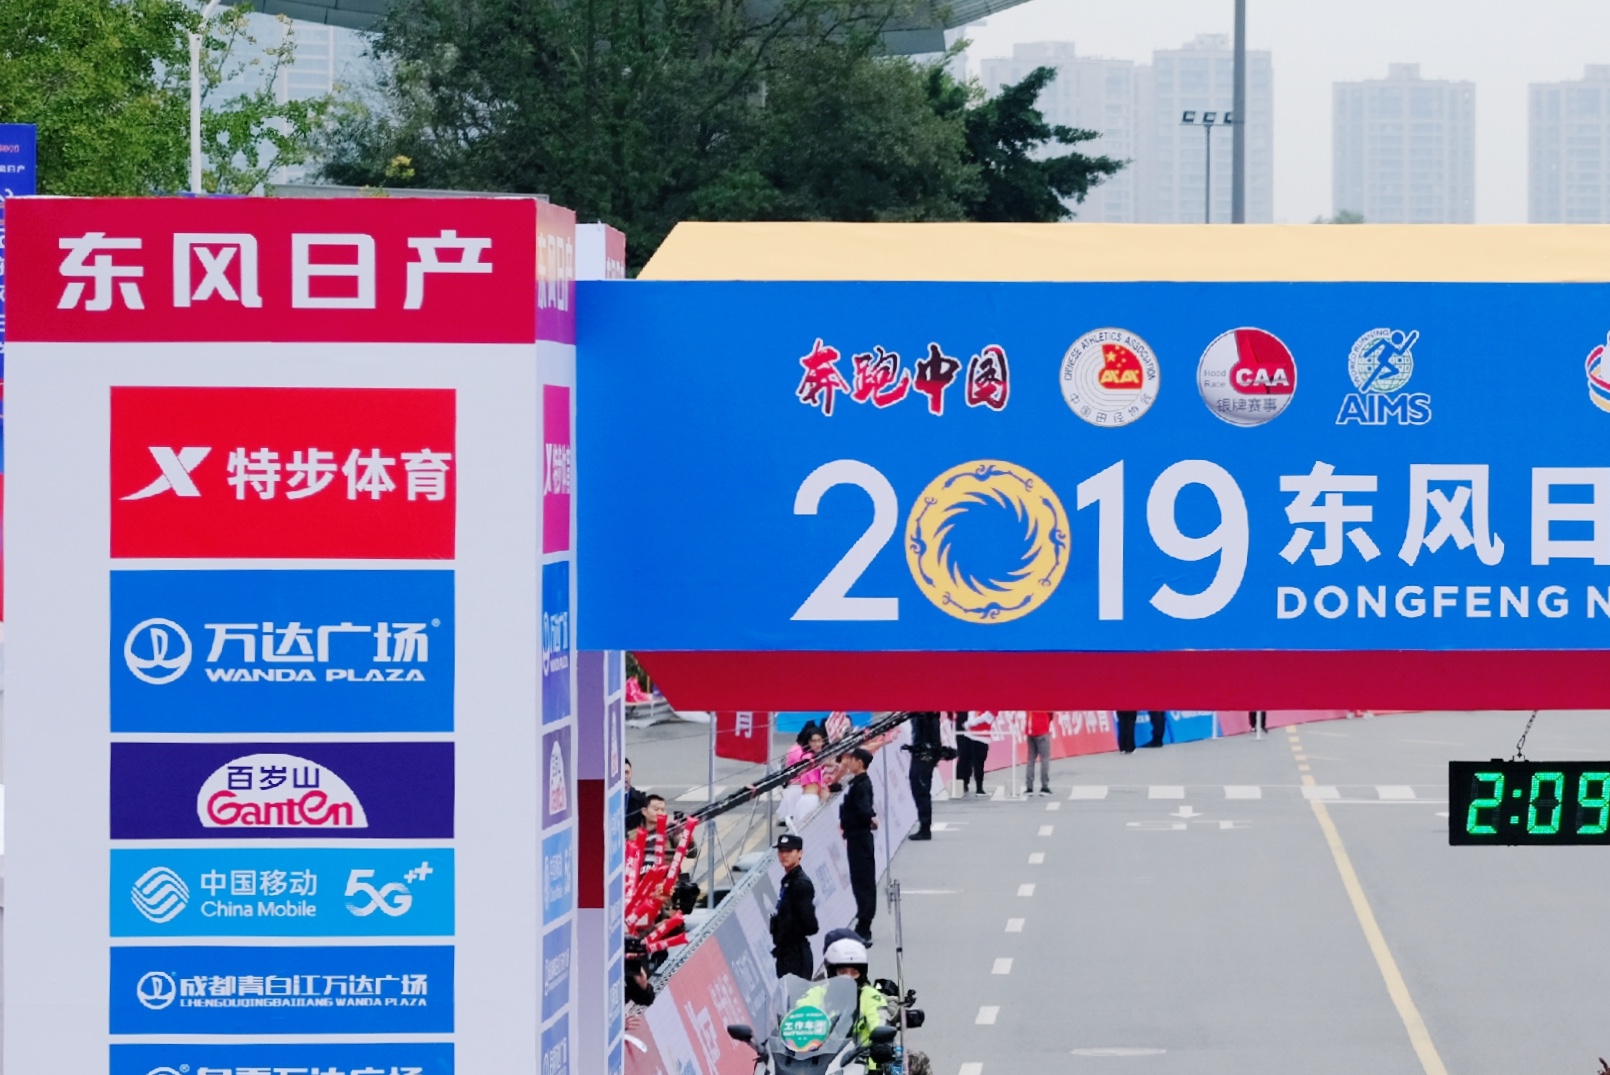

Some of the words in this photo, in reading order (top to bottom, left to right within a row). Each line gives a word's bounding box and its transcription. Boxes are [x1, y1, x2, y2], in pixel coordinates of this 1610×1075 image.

[57, 229, 494, 311] 东风日产
[796, 338, 1009, 417] 奔跑中国
[1235, 367, 1290, 387] CAA
[1336, 393, 1432, 425] AIMS
[227, 448, 452, 501] 特步体育
[1276, 585, 1570, 619] DONGFENG
[204, 621, 428, 663] 万达广场
[205, 668, 317, 682] WANDA
[325, 668, 426, 682] PLAZA
[227, 765, 321, 791] 百岁山
[200, 869, 319, 898] 中国移动
[200, 900, 254, 918] China
[257, 900, 317, 917] Mobile
[179, 974, 428, 997] 成都青白江万达广场
[335, 997, 382, 1007] WANDA
[384, 997, 428, 1007] PLAZA
